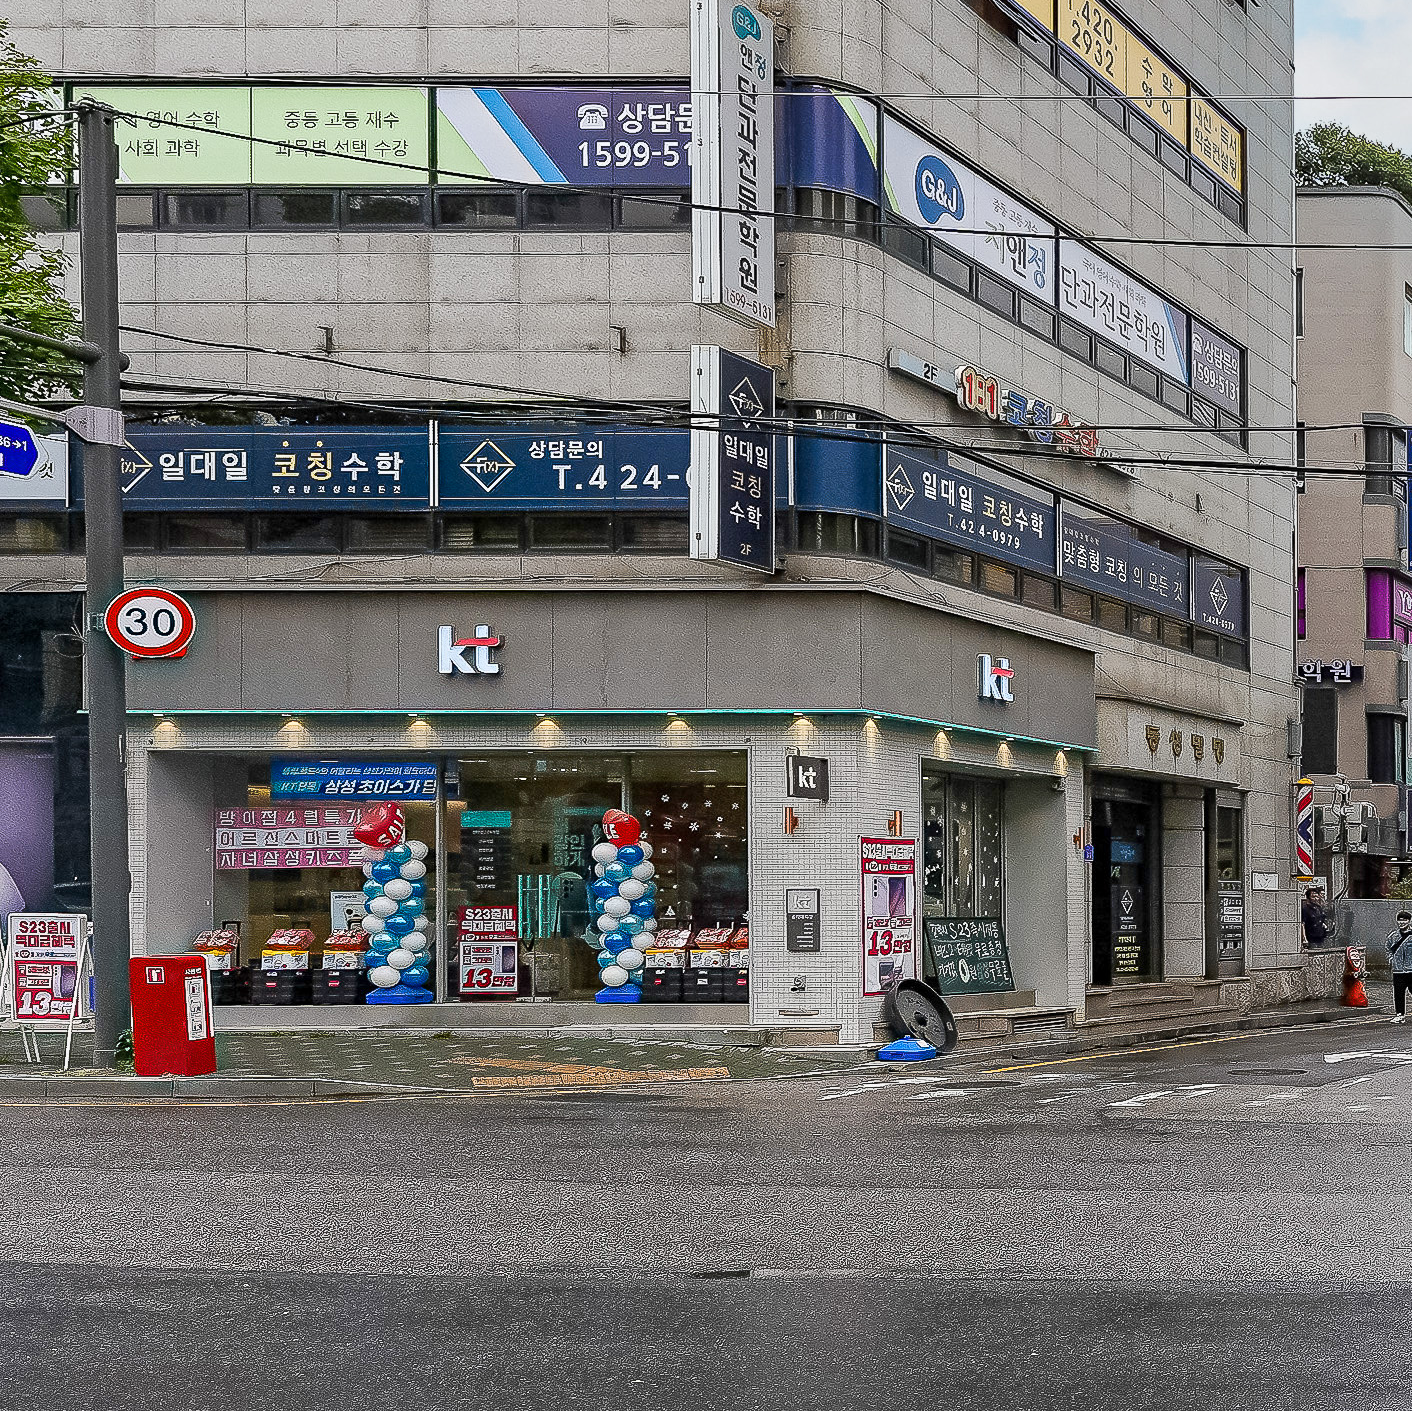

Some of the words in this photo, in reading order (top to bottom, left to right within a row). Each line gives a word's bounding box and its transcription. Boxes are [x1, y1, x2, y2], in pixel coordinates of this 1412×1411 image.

[1072, 20, 1115, 78] 2932
[186, 111, 219, 128] 수학
[284, 111, 319, 128] 중등
[325, 112, 359, 128] 고등
[366, 111, 399, 128] 재수
[125, 139, 158, 157] 사회
[166, 139, 200, 157] 과학
[374, 140, 408, 157] 수강
[922, 170, 960, 218] G&J
[1061, 266, 1165, 362] 단과전문학원
[924, 363, 938, 381] 2F
[529, 441, 602, 458] 상담문의
[725, 435, 767, 469] 일대일
[160, 452, 247, 480] 일대일
[731, 471, 761, 498] 코칭
[922, 472, 973, 510] 일대일
[730, 501, 762, 529] 수학
[741, 544, 751, 555] 2F
[1064, 538, 1099, 572] 맞춤형
[1105, 557, 1127, 582] 코칭
[125, 608, 175, 636] 30
[437, 622, 502, 673] kt
[975, 652, 1014, 701] kt
[1301, 659, 1353, 684] 학원
[799, 766, 816, 788] kt
